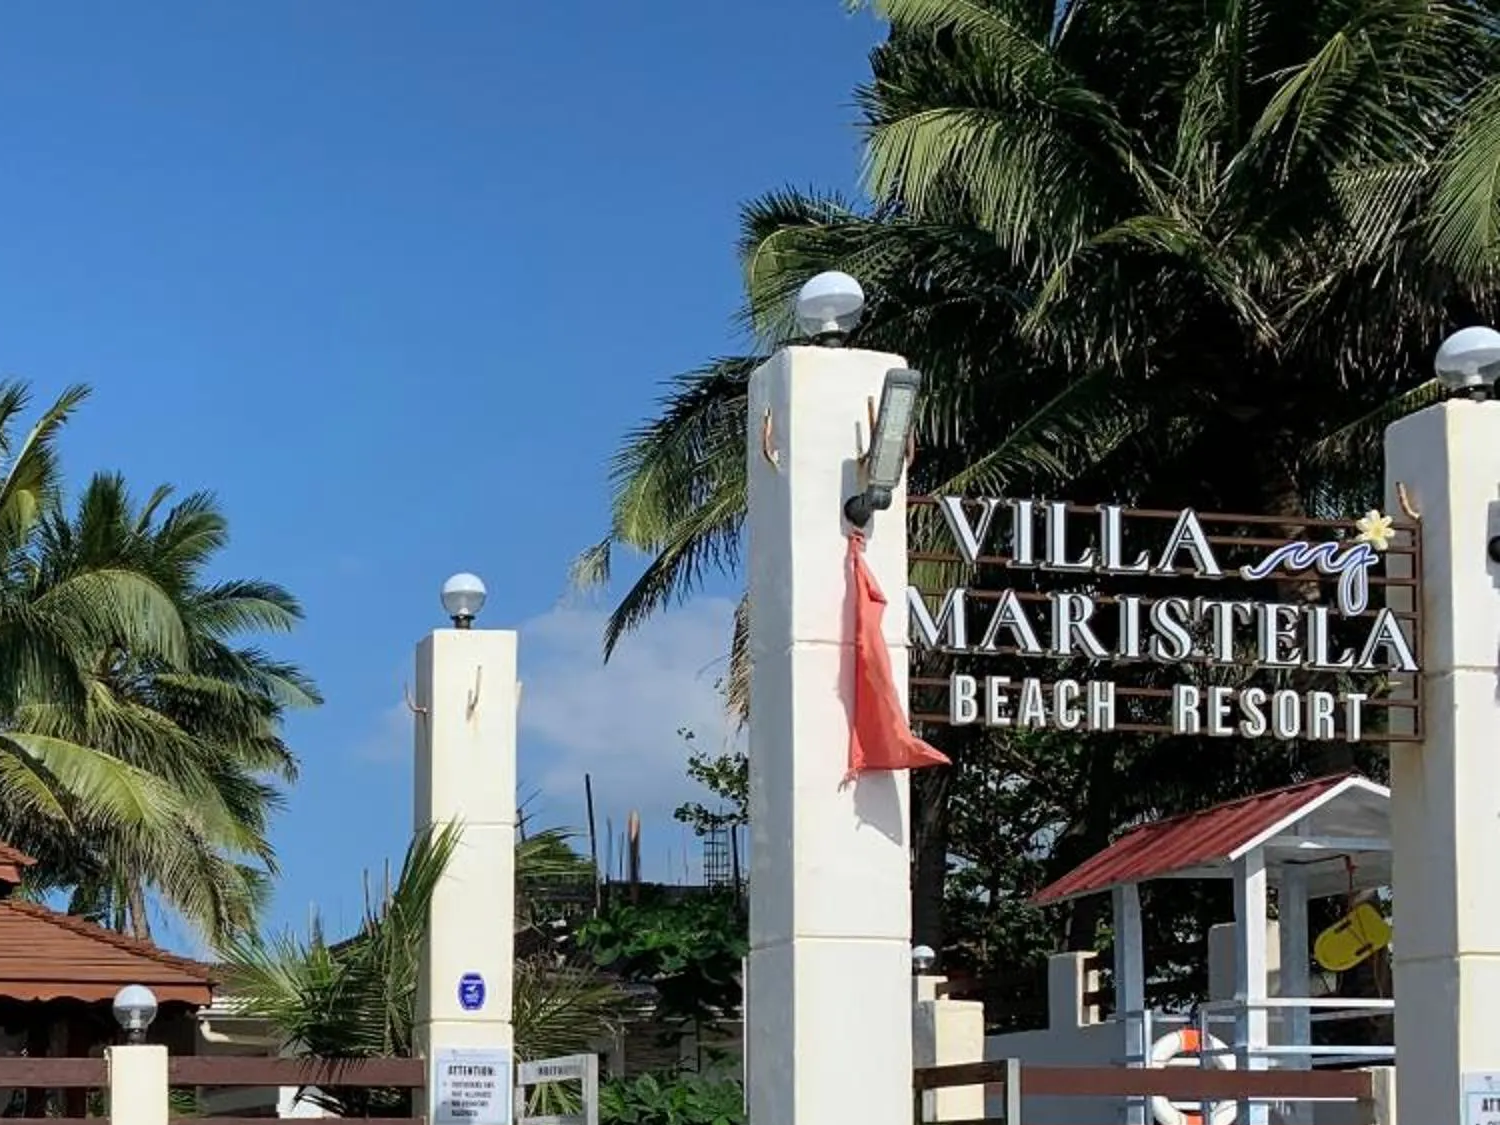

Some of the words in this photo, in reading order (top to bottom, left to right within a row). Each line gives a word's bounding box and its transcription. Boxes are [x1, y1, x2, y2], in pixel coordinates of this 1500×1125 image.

[936, 495, 1224, 579] VILLA
[907, 585, 1419, 673] MARISTELA
[950, 673, 1116, 731] BEACH
[1172, 684, 1368, 741] RESORT
